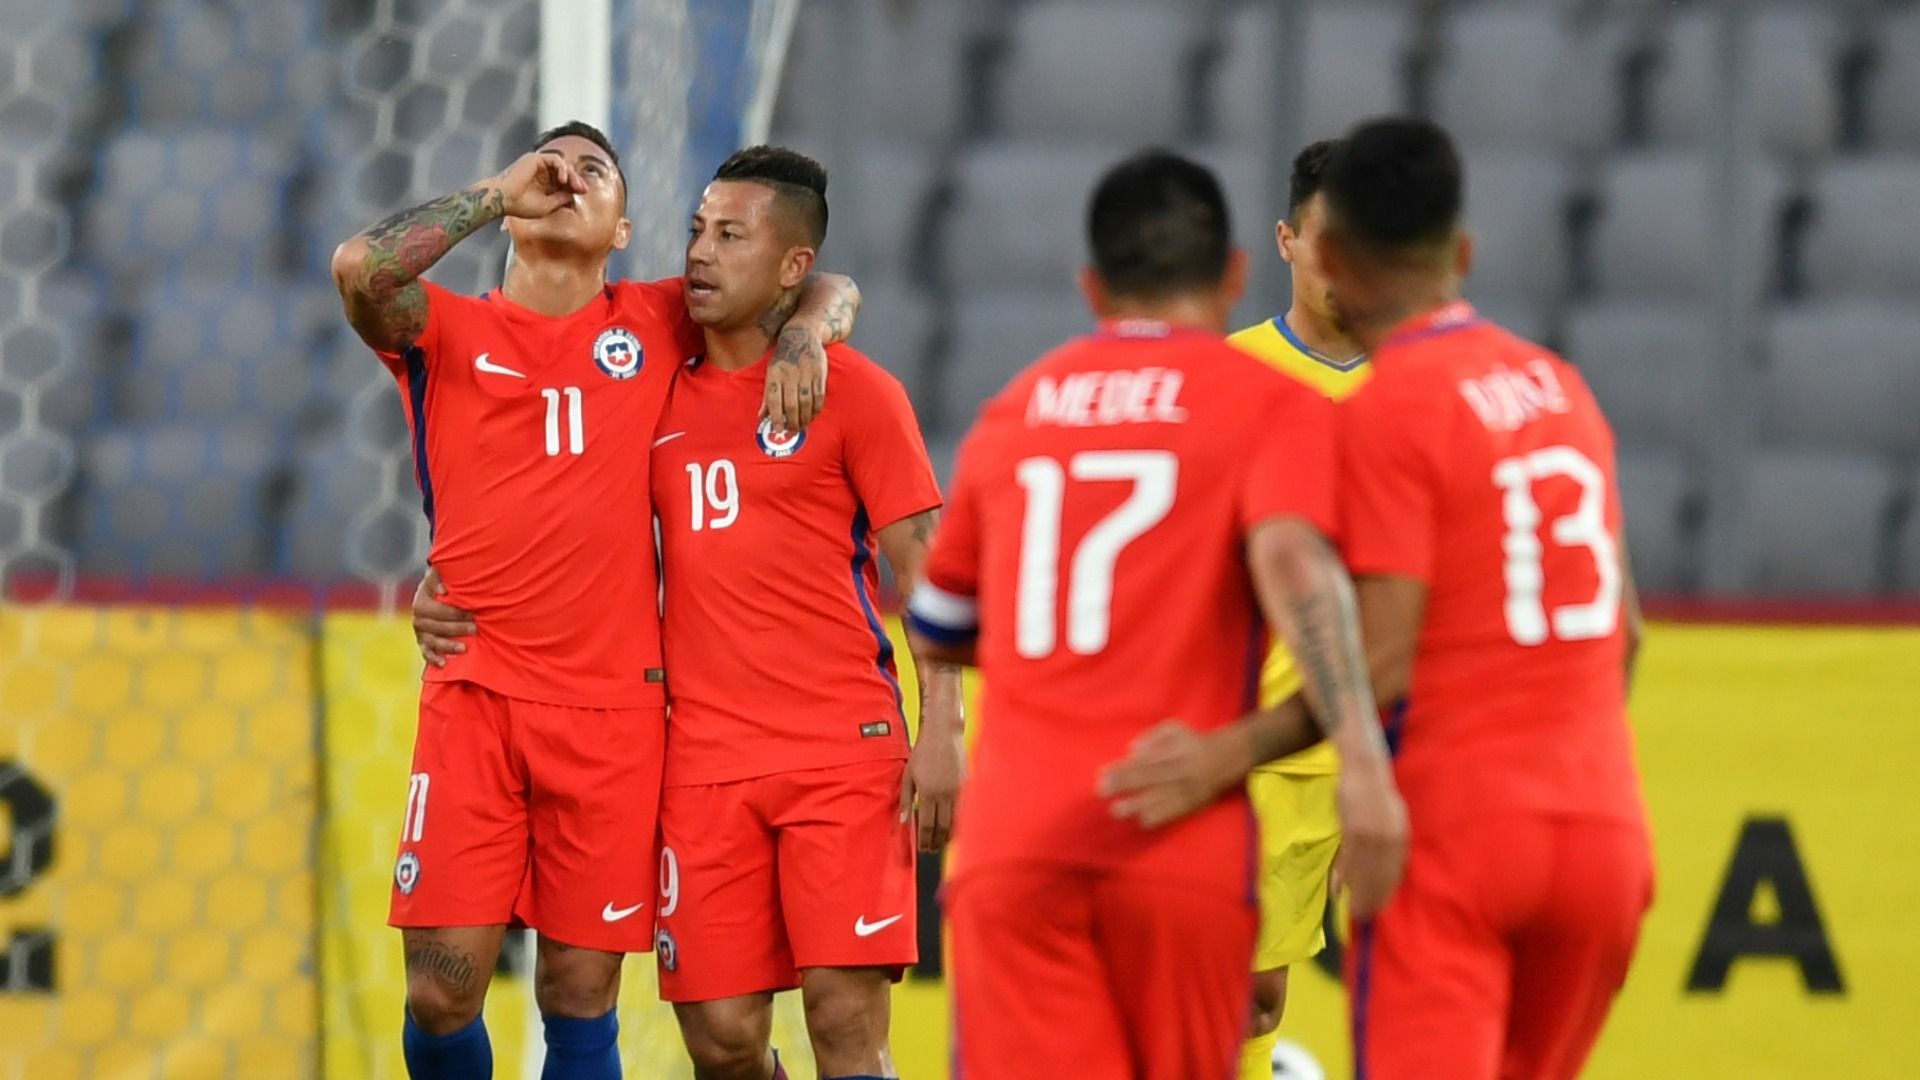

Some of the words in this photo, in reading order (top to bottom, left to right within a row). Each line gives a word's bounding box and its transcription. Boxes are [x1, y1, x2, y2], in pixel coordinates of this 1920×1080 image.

[541, 386, 584, 456] 11
[1025, 366, 1189, 427] MEDEL
[685, 458, 740, 532] 19
[1015, 451, 1179, 658] 17
[1492, 445, 1624, 646] 13
[403, 773, 430, 843] 11
[1682, 815, 1849, 997] A
